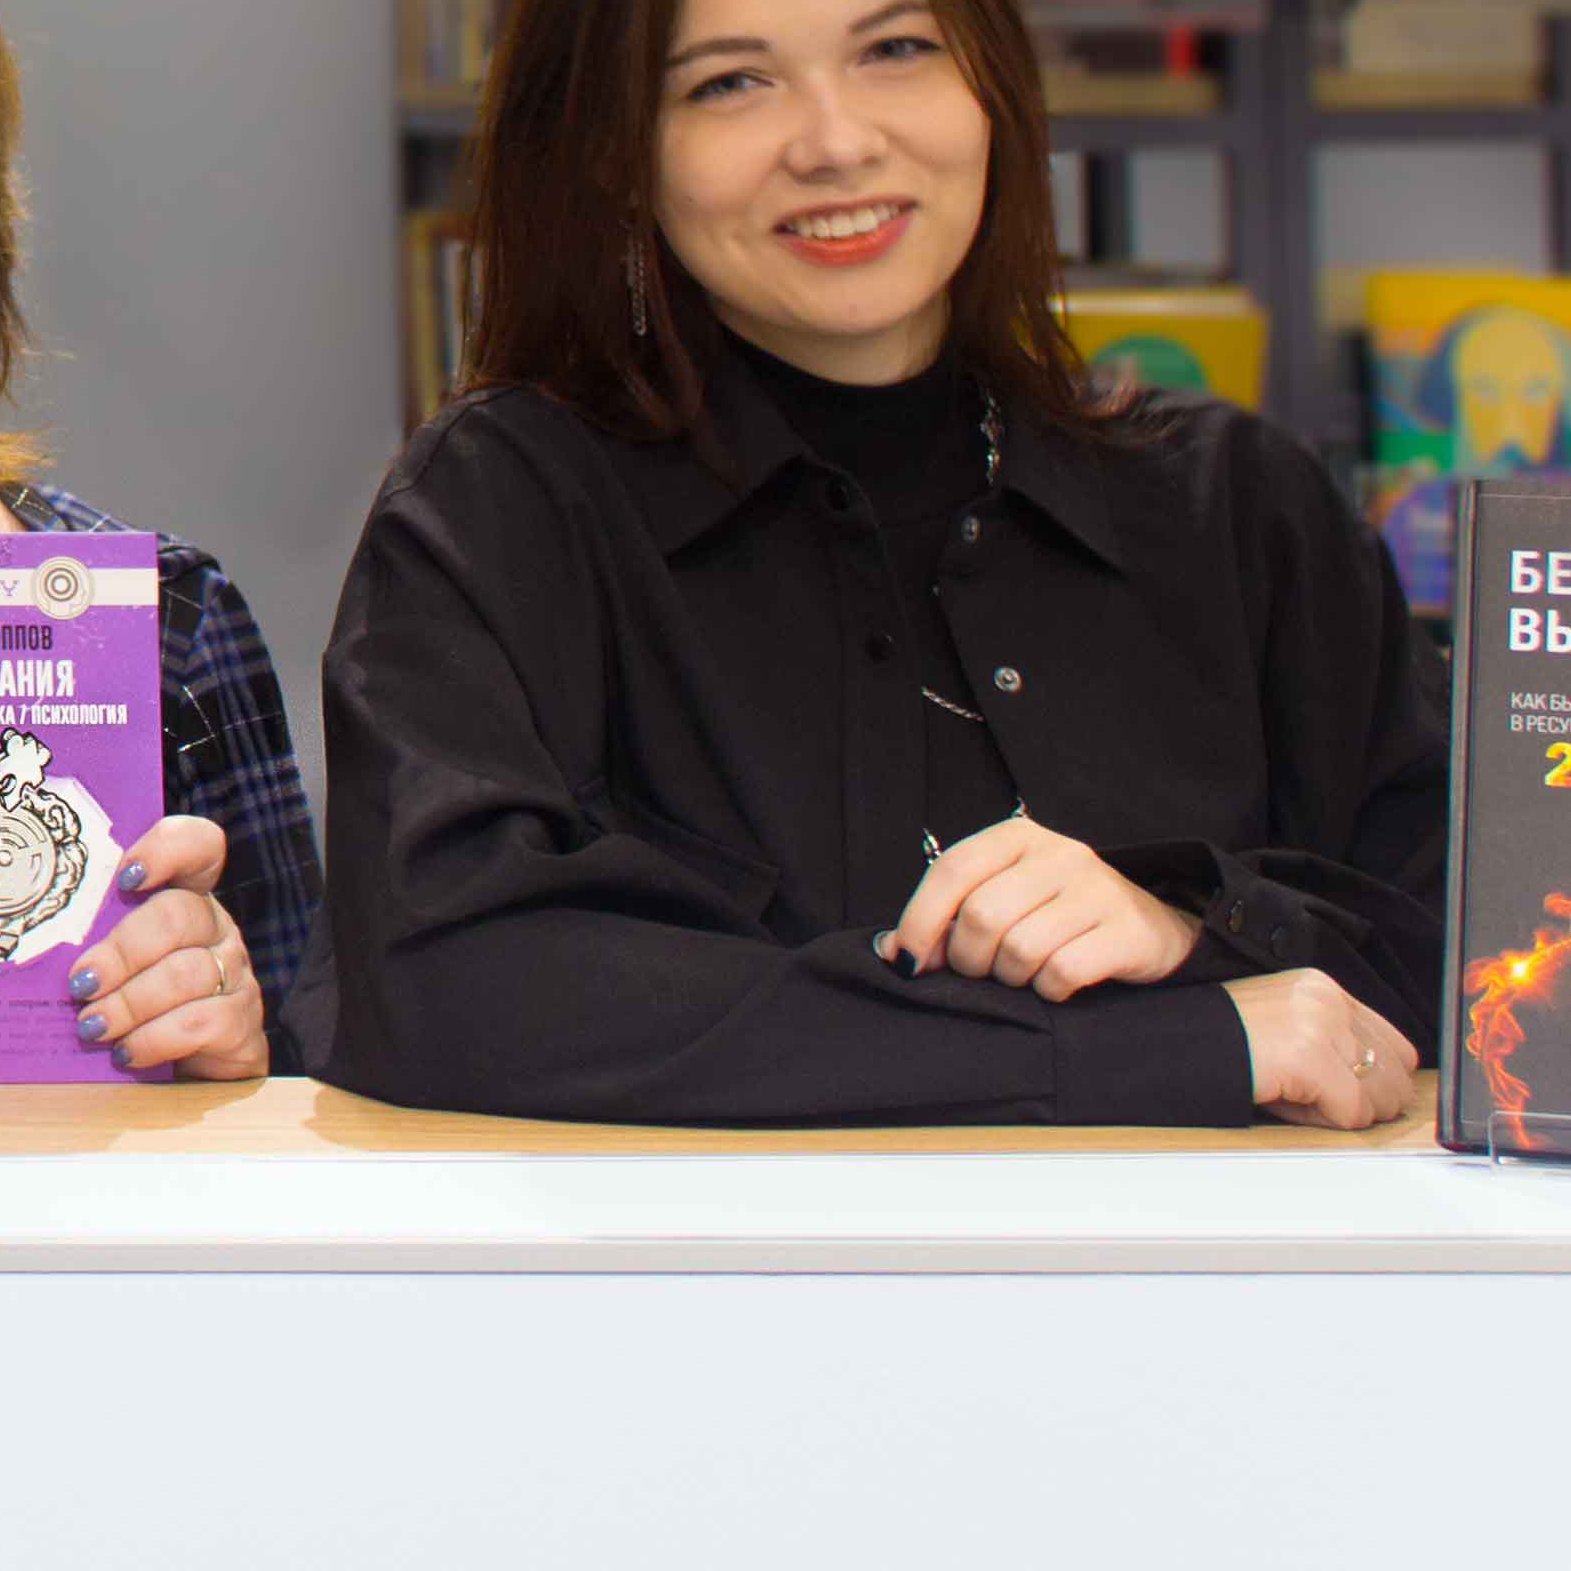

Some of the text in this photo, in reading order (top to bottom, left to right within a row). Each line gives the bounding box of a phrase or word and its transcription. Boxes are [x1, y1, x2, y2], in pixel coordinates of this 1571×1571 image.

[1510, 691, 1548, 710] КАК
[31, 703, 128, 725] ПСИХОЛОГИЯ
[1510, 714, 1524, 732] В
